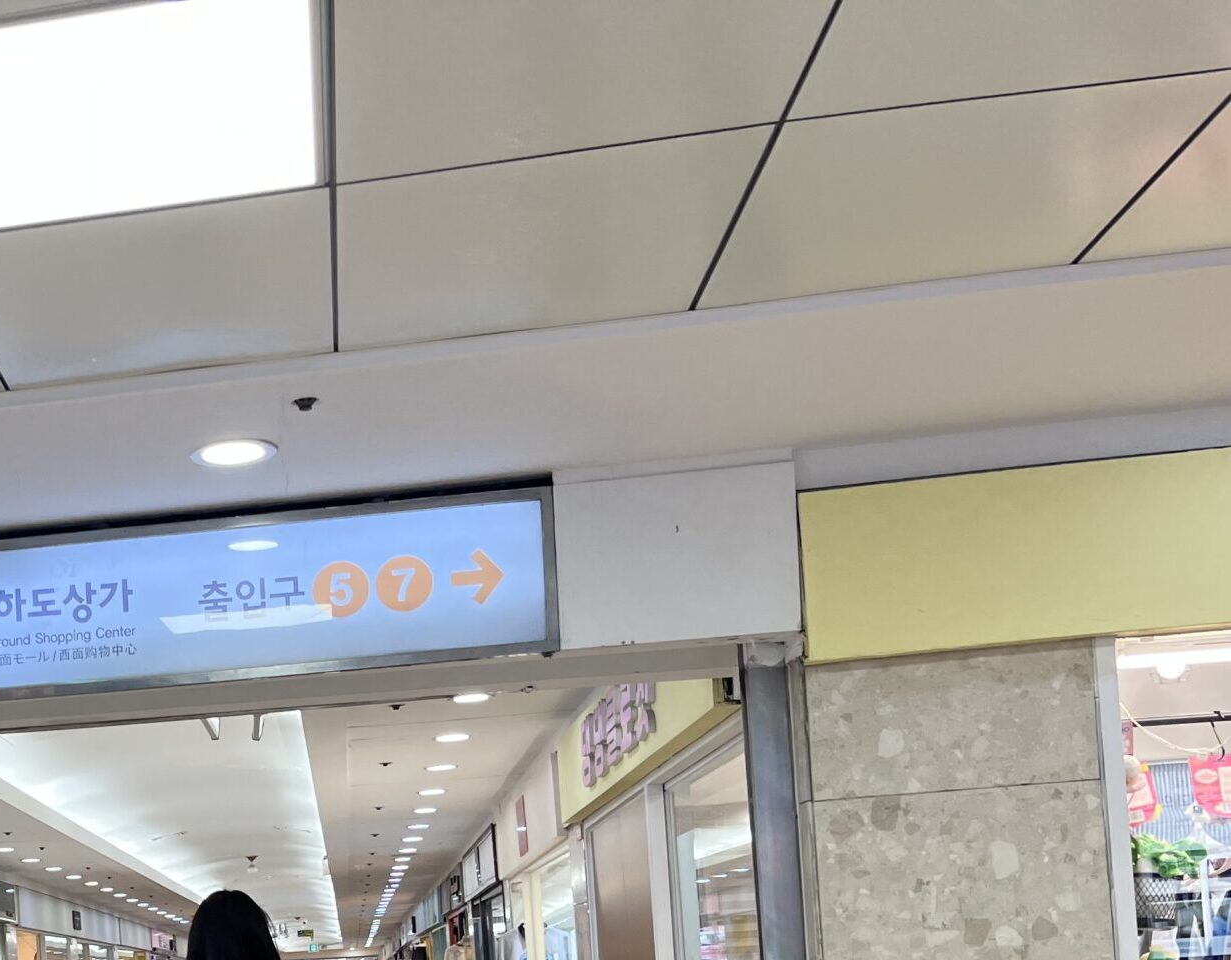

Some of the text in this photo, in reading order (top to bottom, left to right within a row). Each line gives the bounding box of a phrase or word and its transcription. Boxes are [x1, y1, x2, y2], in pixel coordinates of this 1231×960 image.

[328, 572, 354, 607] 5
[390, 567, 416, 603] 7
[34, 629, 91, 646] Shopping
[95, 626, 136, 639] Center
